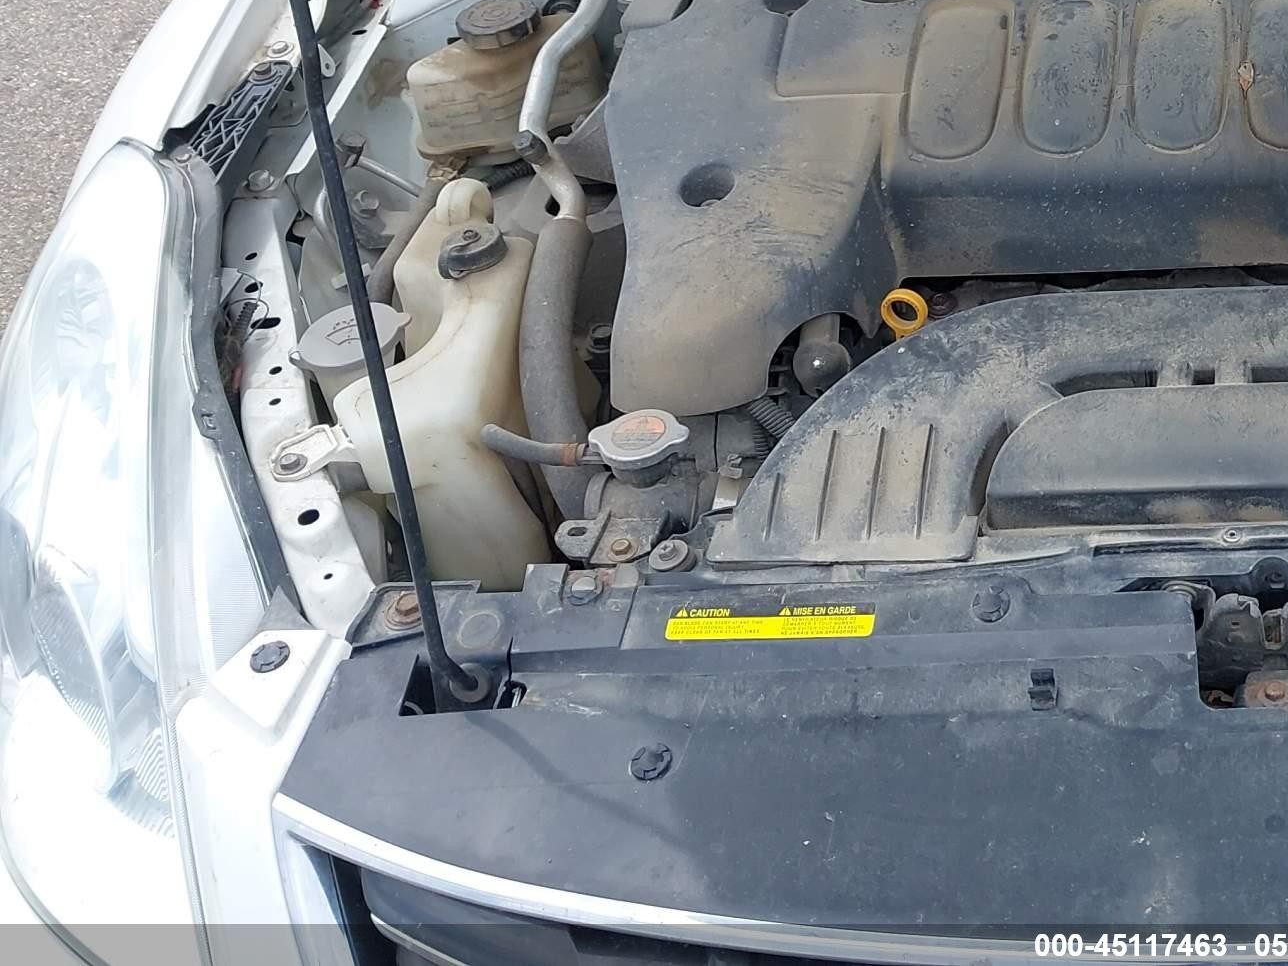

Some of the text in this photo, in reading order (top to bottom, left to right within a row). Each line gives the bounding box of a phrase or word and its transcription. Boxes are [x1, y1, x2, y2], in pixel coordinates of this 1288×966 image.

[689, 608, 731, 617] CAUTION
[792, 606, 857, 616] MISE EN GARDE
